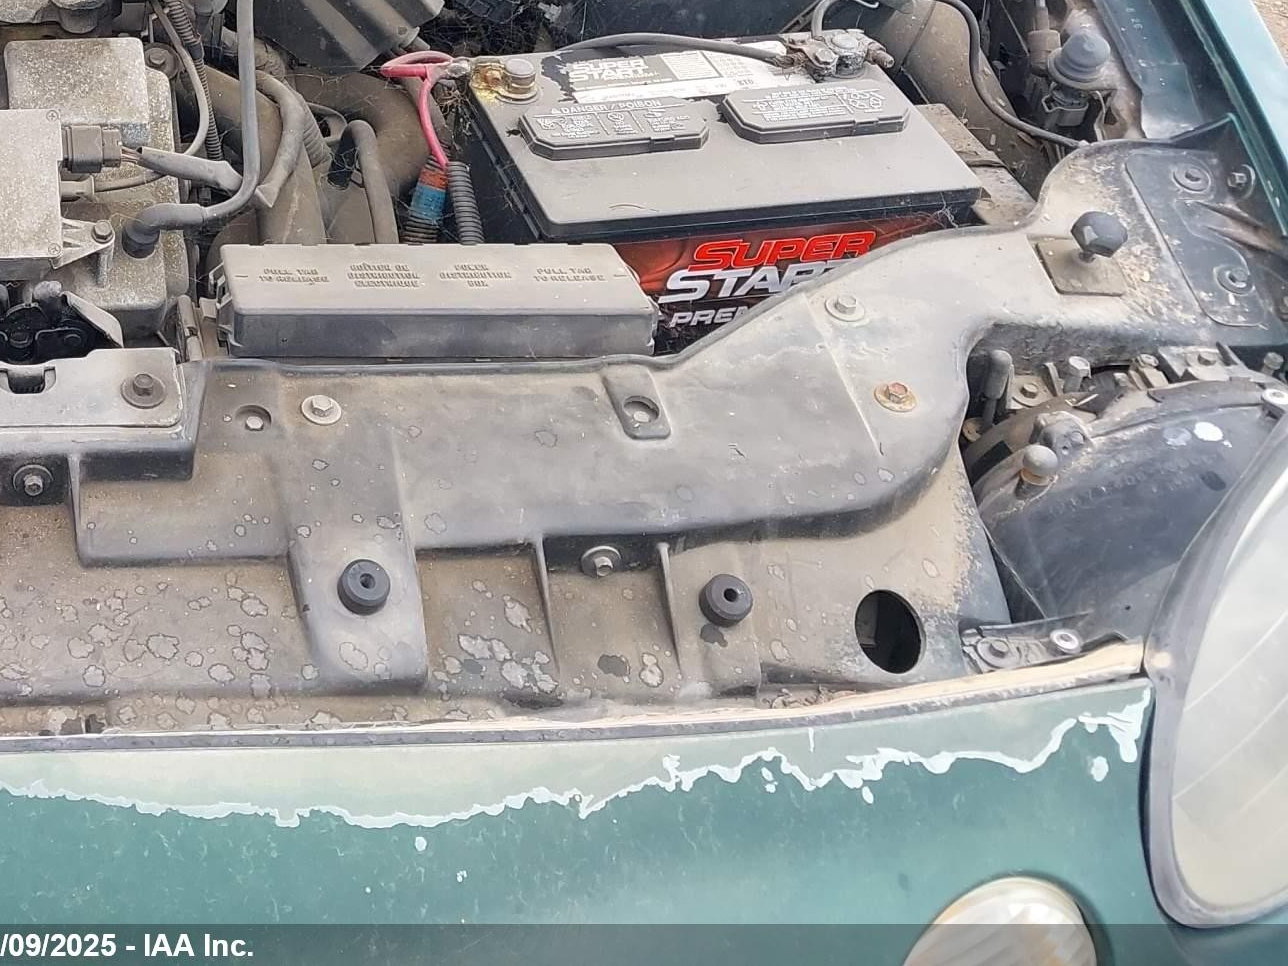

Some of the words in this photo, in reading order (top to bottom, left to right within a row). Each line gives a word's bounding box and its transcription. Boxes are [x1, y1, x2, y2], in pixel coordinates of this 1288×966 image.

[572, 58, 646, 71] SUPER
[569, 66, 649, 82] START
[560, 104, 609, 114] DANGER
[687, 231, 878, 272] SUPER
